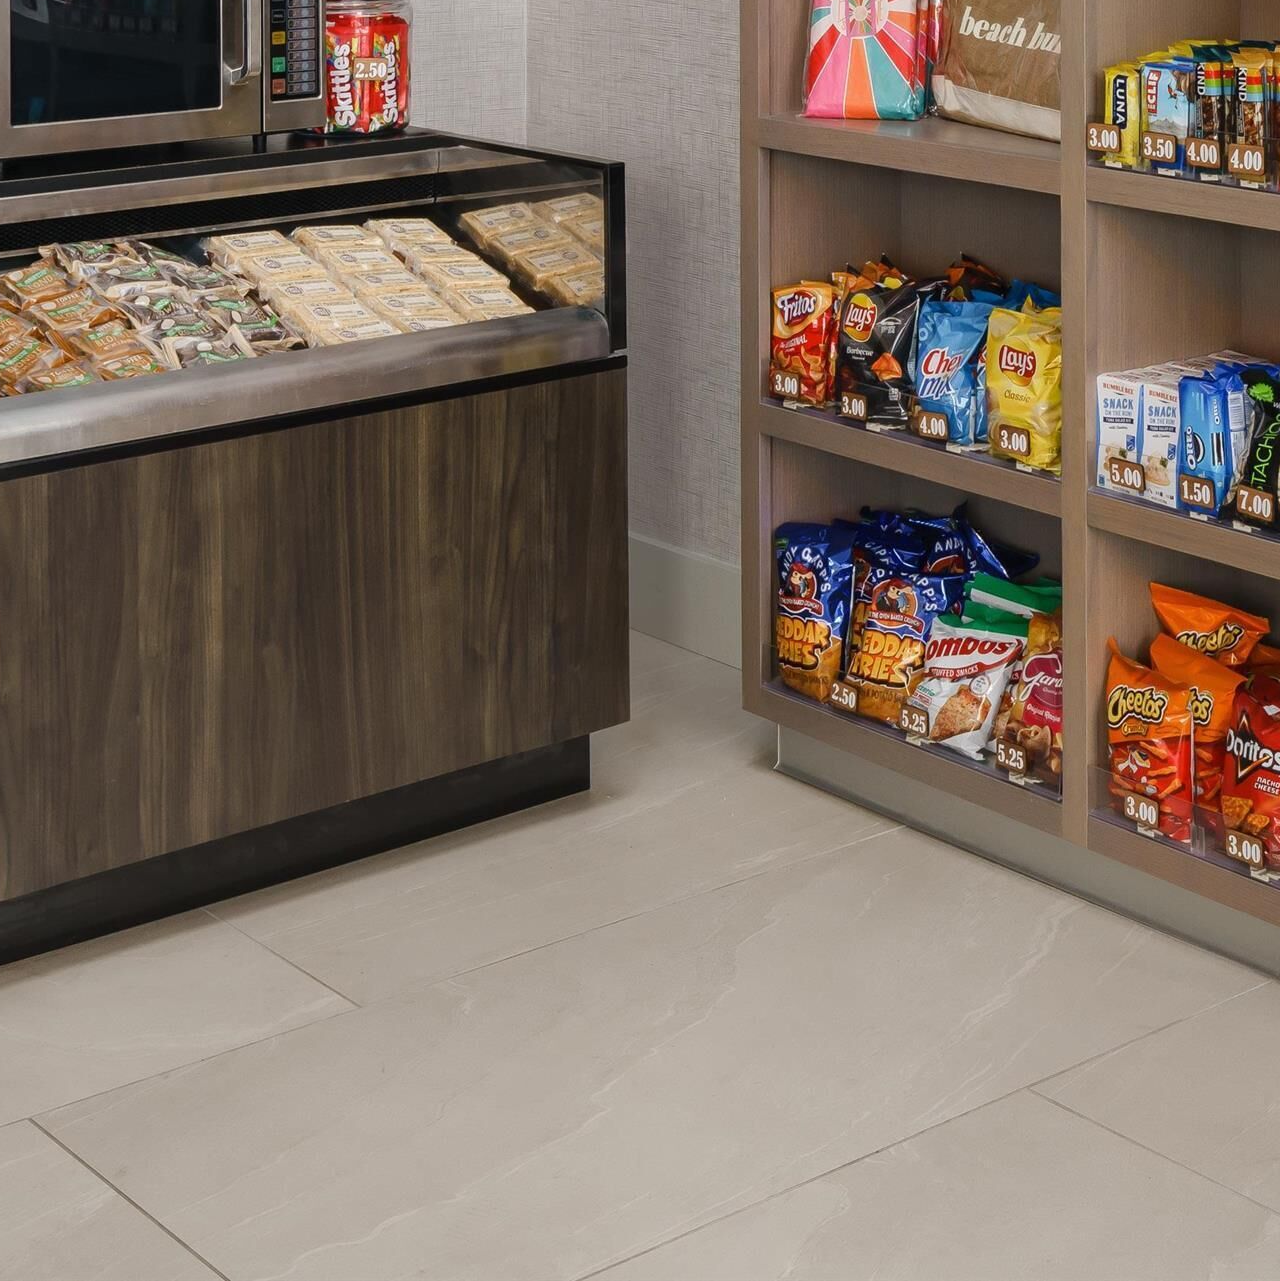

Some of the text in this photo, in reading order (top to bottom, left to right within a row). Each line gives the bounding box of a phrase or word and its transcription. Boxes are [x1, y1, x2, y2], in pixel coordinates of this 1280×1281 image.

[959, 5, 1027, 48] beach
[355, 62, 387, 78] 2.50
[331, 42, 357, 127] Skittles
[1115, 78, 1126, 125] LUNA
[1089, 127, 1118, 149] 3.00
[1143, 136, 1174, 159] 3.50
[1187, 141, 1218, 164] 4.00
[1230, 148, 1262, 171] 4.00
[777, 292, 817, 326] Fritos
[845, 303, 875, 332] Lay's
[1001, 345, 1035, 376] Lay's
[775, 373, 798, 395] 3.00
[1004, 389, 1031, 403] Classic
[842, 395, 865, 417] 3.00
[919, 415, 946, 436] 4.00
[1000, 429, 1027, 453] 3.00
[1111, 464, 1142, 489] 5.00
[1182, 482, 1211, 505] 1.50
[1239, 490, 1272, 519] 7.00
[831, 683, 856, 709] 2.50
[1107, 685, 1166, 724] Cheetos
[901, 709, 926, 734] 5.25
[997, 743, 1024, 770] 5.25
[1126, 795, 1157, 825] 3.00
[1228, 834, 1261, 865] 3.00
